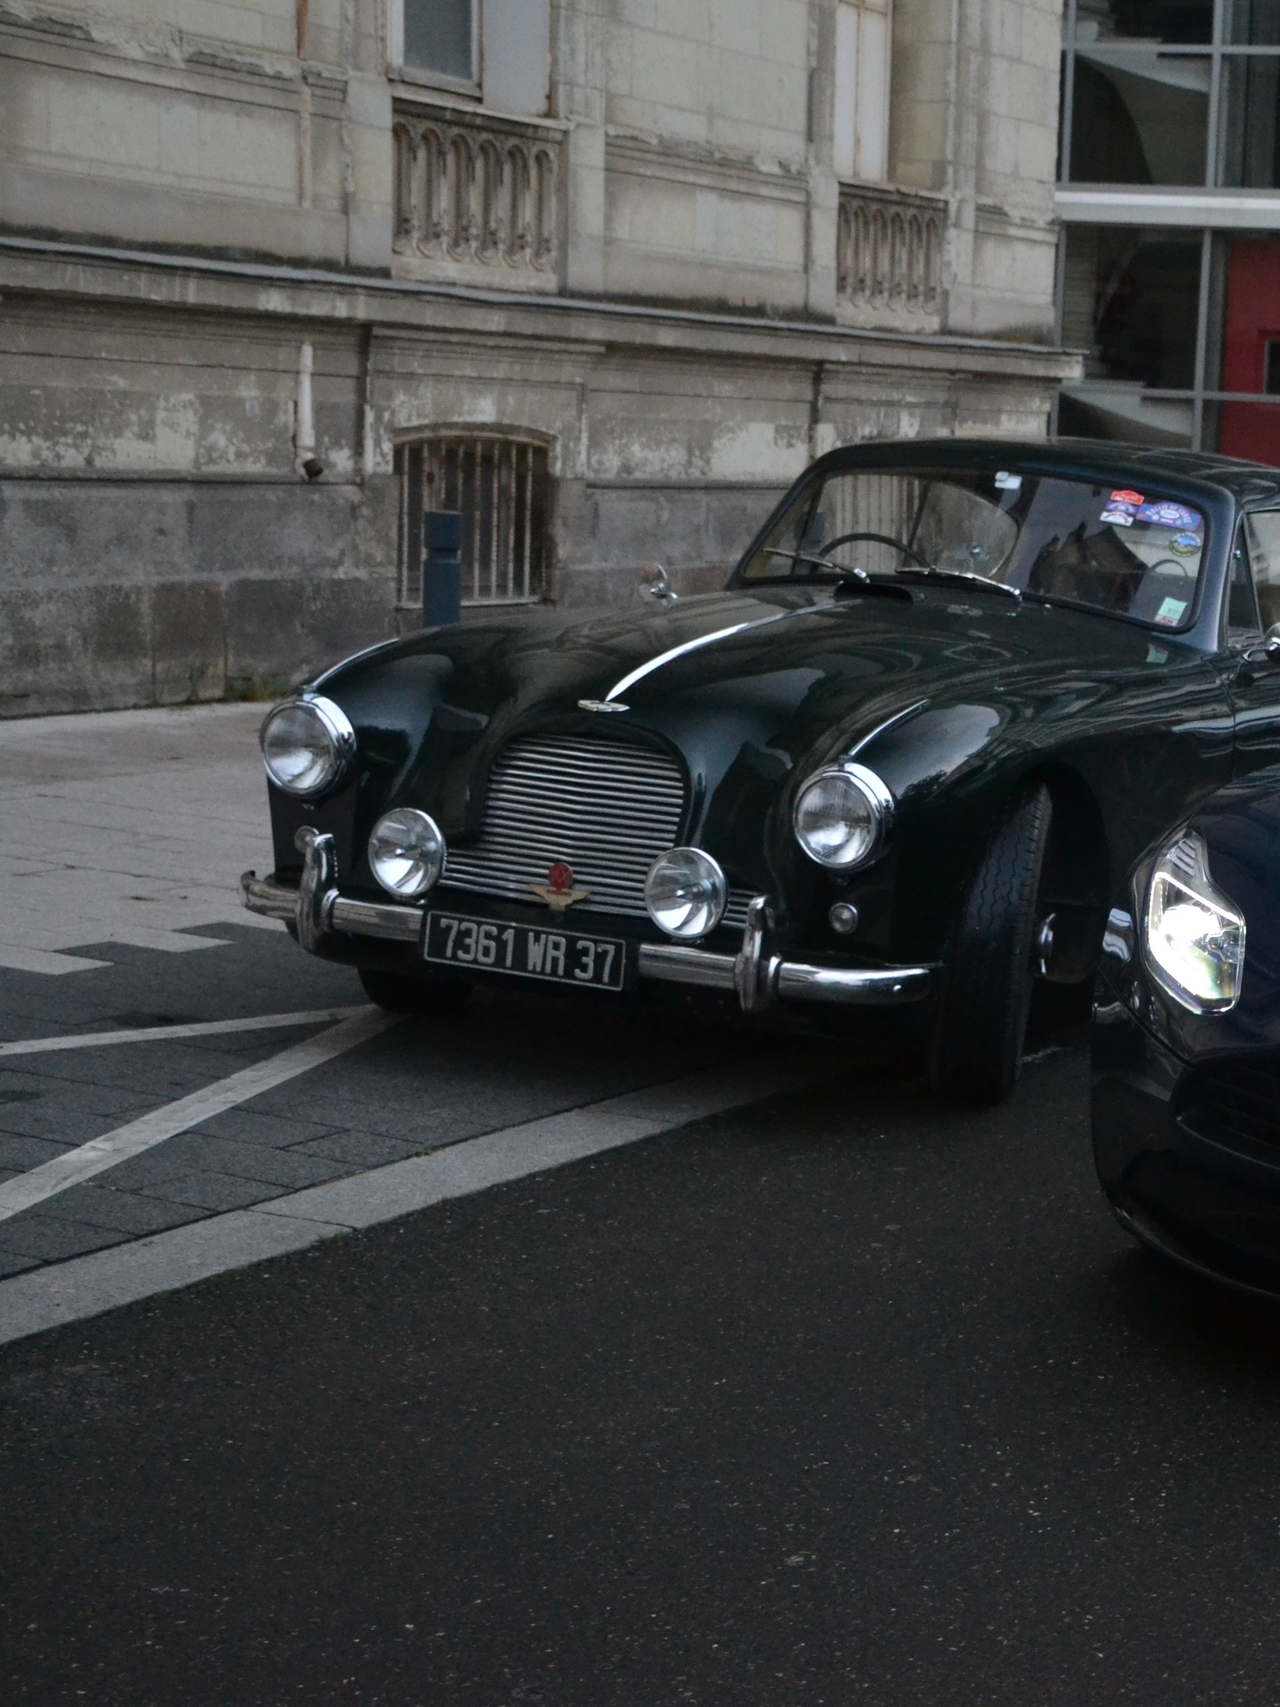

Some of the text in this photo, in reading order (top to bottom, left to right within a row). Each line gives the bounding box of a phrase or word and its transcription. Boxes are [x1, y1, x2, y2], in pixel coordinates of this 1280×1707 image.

[440, 919, 617, 983] 7361 WR 37
